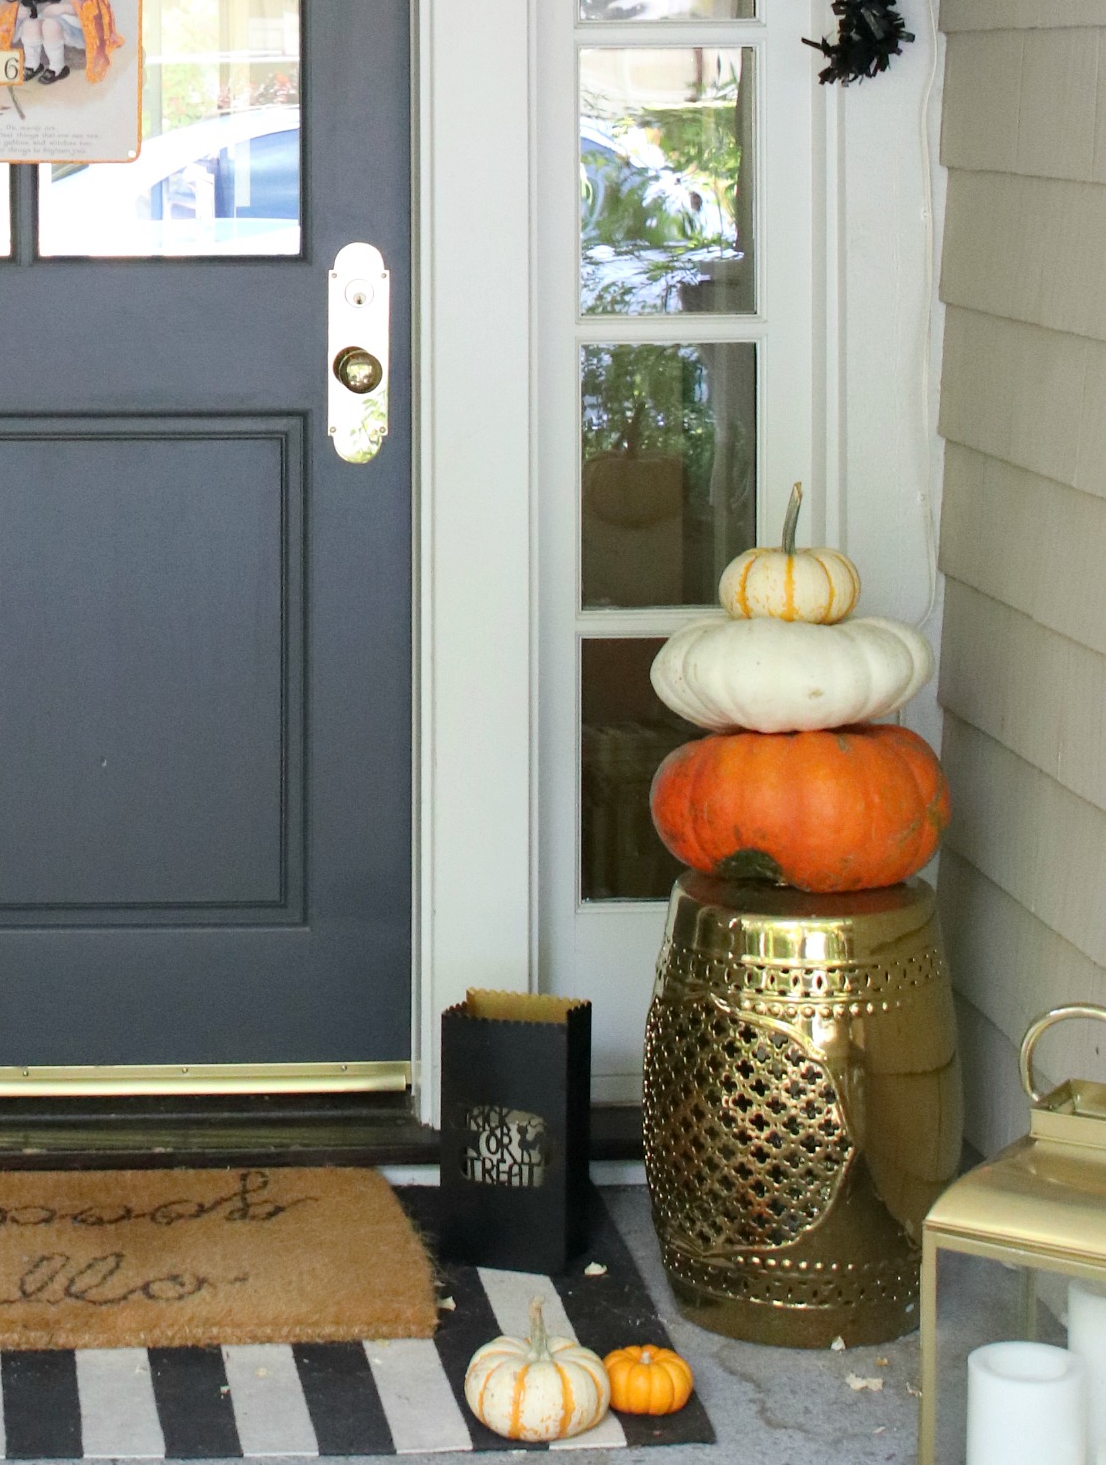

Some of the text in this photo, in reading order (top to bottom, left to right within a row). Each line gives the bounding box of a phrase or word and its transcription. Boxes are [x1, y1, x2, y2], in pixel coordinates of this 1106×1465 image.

[4, 57, 19, 80] 6
[463, 1104, 511, 1132] RICK
[486, 1132, 516, 1163] OR
[464, 1157, 535, 1187] TREAT
